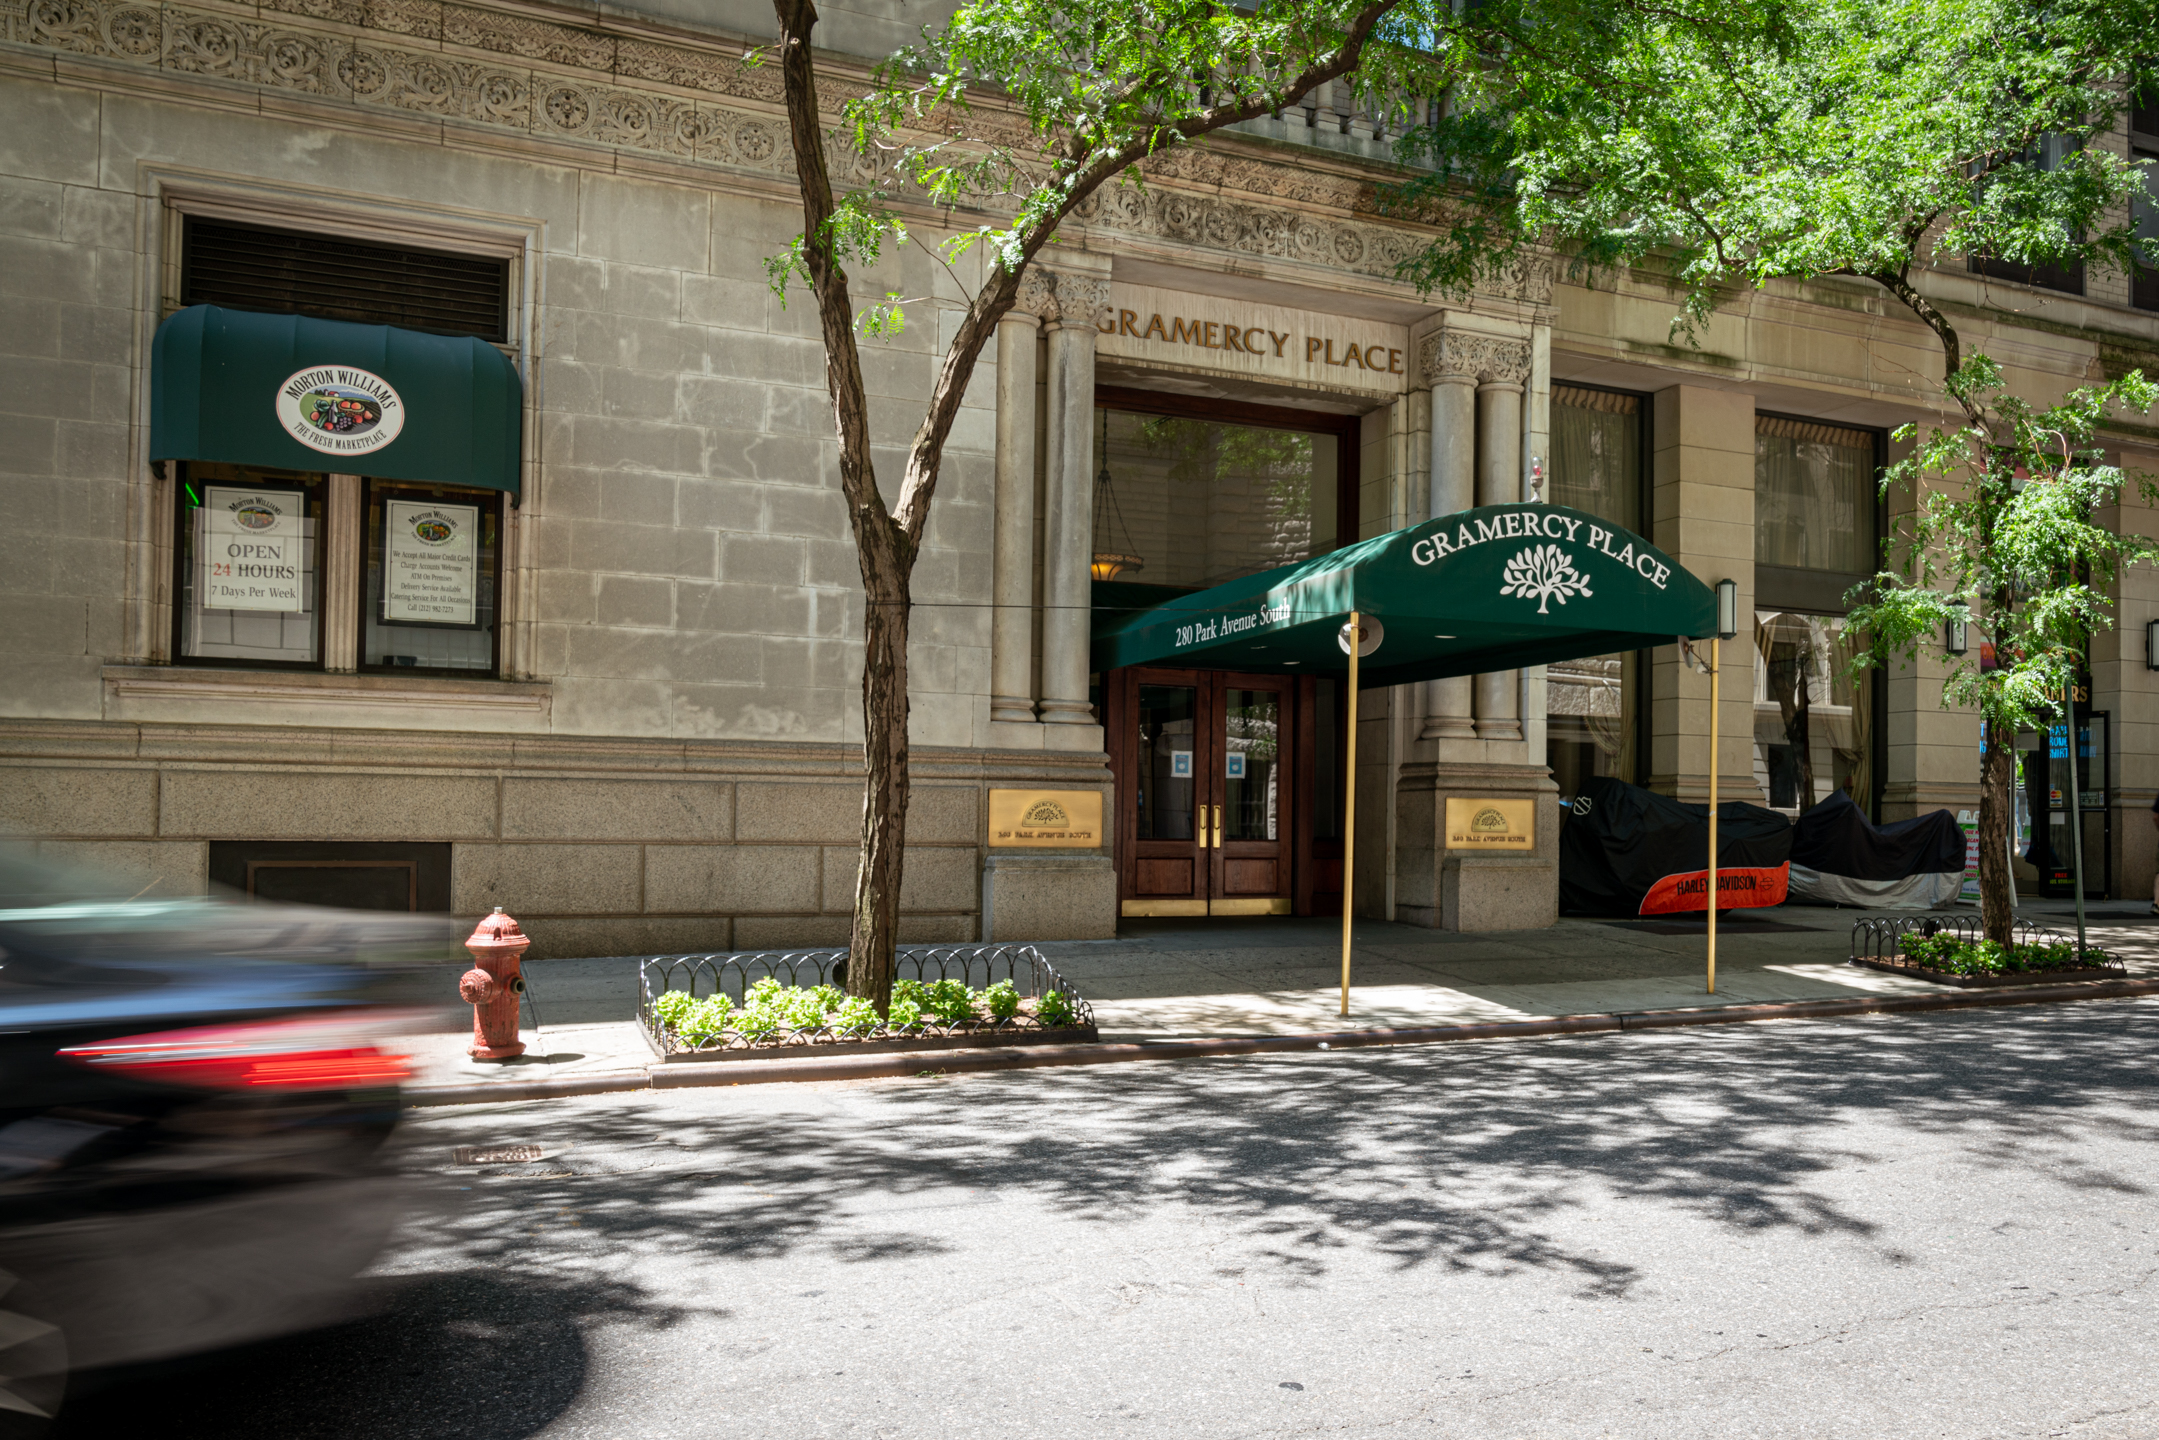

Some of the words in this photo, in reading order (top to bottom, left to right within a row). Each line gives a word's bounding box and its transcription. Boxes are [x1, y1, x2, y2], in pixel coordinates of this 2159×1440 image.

[1096, 306, 1290, 358] GRAMERCY
[1307, 336, 1405, 375] PLACE
[285, 369, 334, 401] MORTON
[337, 370, 397, 410] WILLIAMS
[293, 421, 311, 438] THE
[309, 431, 333, 449] FRESH
[335, 429, 387, 450] MARKETPLACE
[228, 497, 255, 513] MORTON
[255, 496, 283, 516] WILLIAMS
[408, 511, 432, 526] MORTON
[432, 510, 458, 529] WILLIAMS
[227, 543, 281, 559] OPEN
[393, 550, 401, 558] We
[402, 551, 418, 560] Accept
[427, 553, 441, 561] Major
[442, 553, 457, 561] Credit
[457, 554, 471, 562] Cards
[1411, 512, 1583, 566] GRAMERCY
[1586, 523, 1671, 591] PLACE
[213, 562, 232, 576] 24
[238, 563, 295, 579] HOURS
[401, 561, 417, 570] Charge
[418, 563, 440, 571] Accounts
[442, 564, 462, 572] Welcome
[410, 572, 422, 580] ATM
[431, 574, 452, 582] Premises
[211, 585, 218, 595] 7
[221, 585, 246, 599] Days
[249, 586, 265, 597] Per
[269, 587, 296, 599] Week
[400, 583, 420, 592] Delivery
[421, 584, 438, 592] Service
[440, 585, 461, 593] Available
[391, 593, 411, 602] Catering
[412, 594, 429, 602] Service
[447, 596, 471, 604] Occasions
[407, 603, 417, 611] Call
[418, 604, 431, 613] (212)
[1175, 625, 1193, 647] 280
[1195, 618, 1217, 643] Park
[1219, 613, 1257, 637] Avenue
[1259, 596, 1291, 626] South
[1026, 801, 1053, 820] GRAMERCY
[1052, 803, 1065, 820] PLACE
[1014, 831, 1034, 839] PARK
[1677, 878, 1709, 896] HARLEY
[1715, 875, 1757, 891] DAVIDSON
